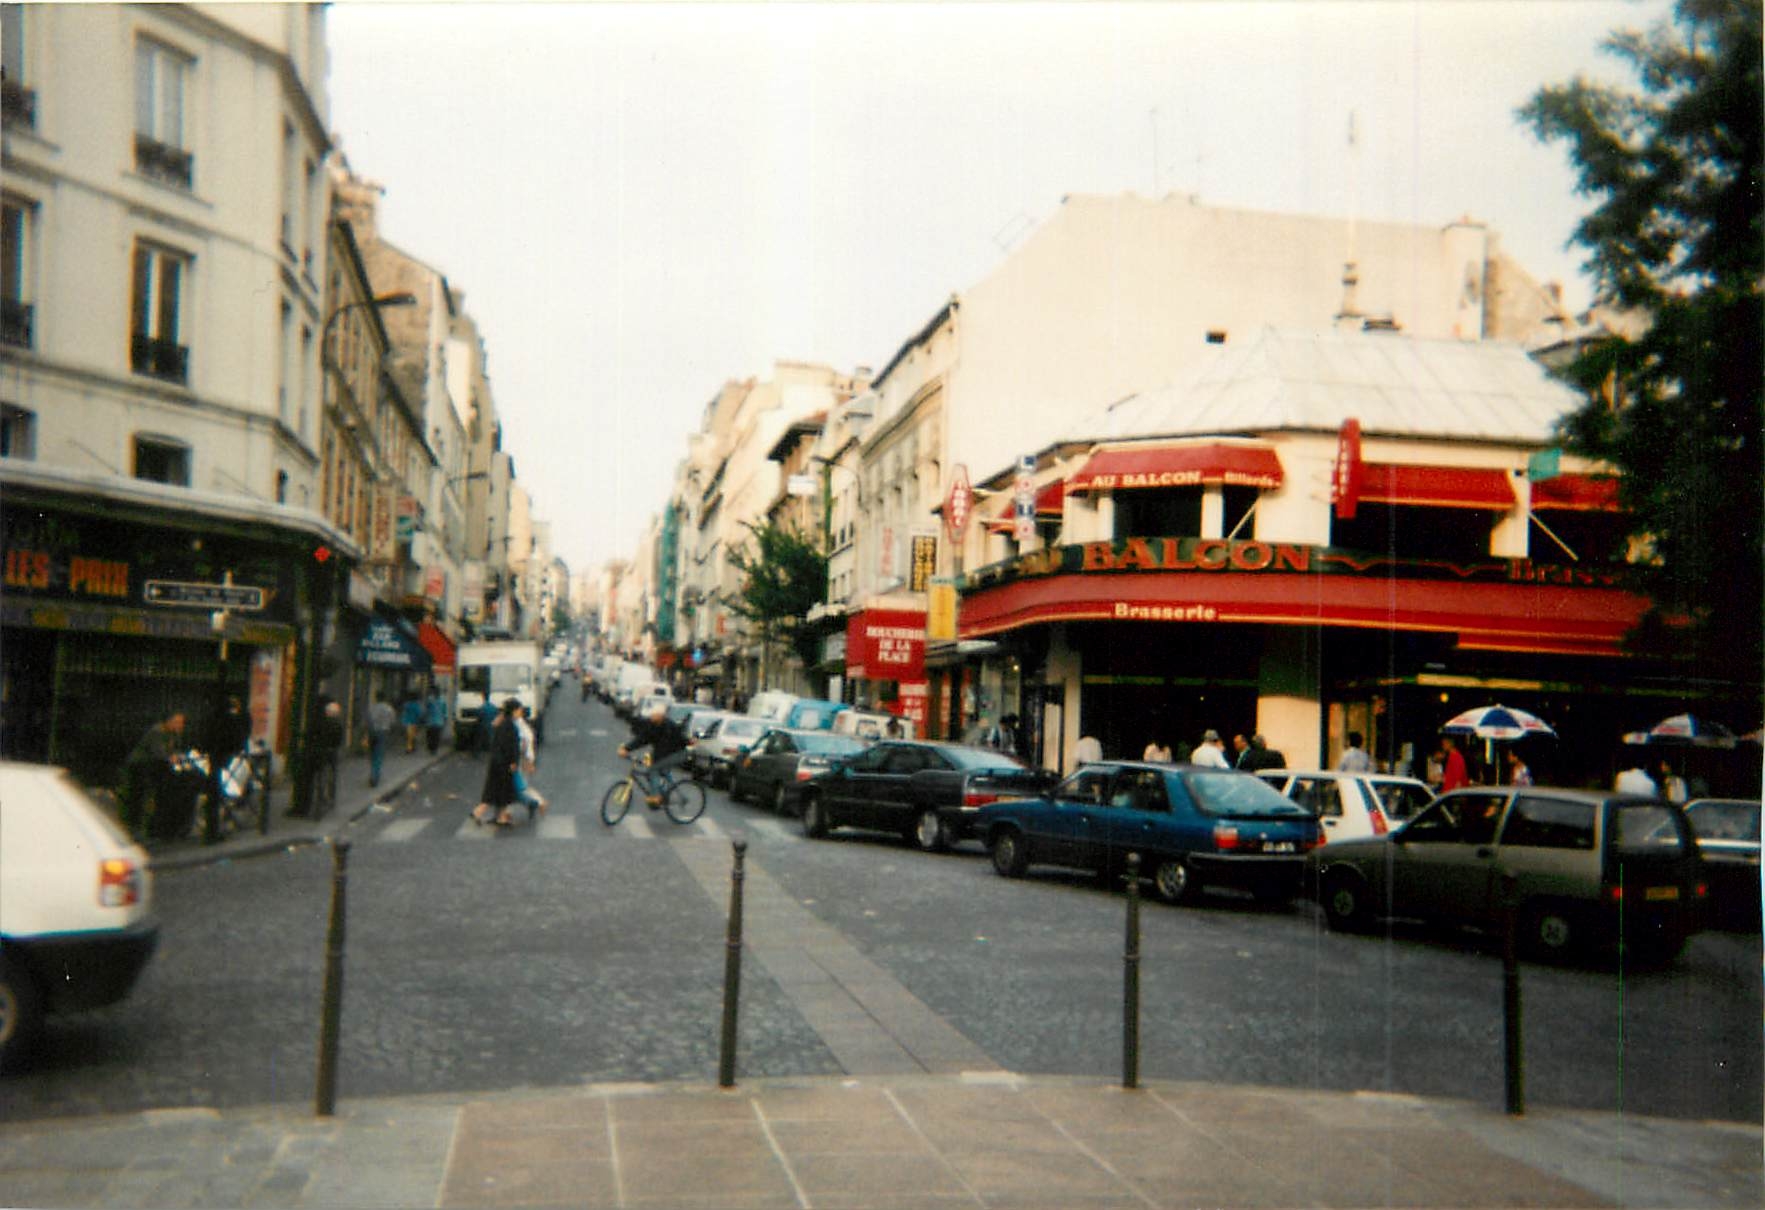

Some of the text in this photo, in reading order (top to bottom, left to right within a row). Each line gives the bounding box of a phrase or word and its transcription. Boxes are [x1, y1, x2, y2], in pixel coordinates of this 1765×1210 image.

[1092, 474, 1116, 487] AU
[1122, 471, 1201, 487] BALCON
[1082, 537, 1310, 572] BALCON
[4, 550, 50, 589] LES
[69, 556, 129, 597] PRIX
[1114, 602, 1217, 621] Brasserie
